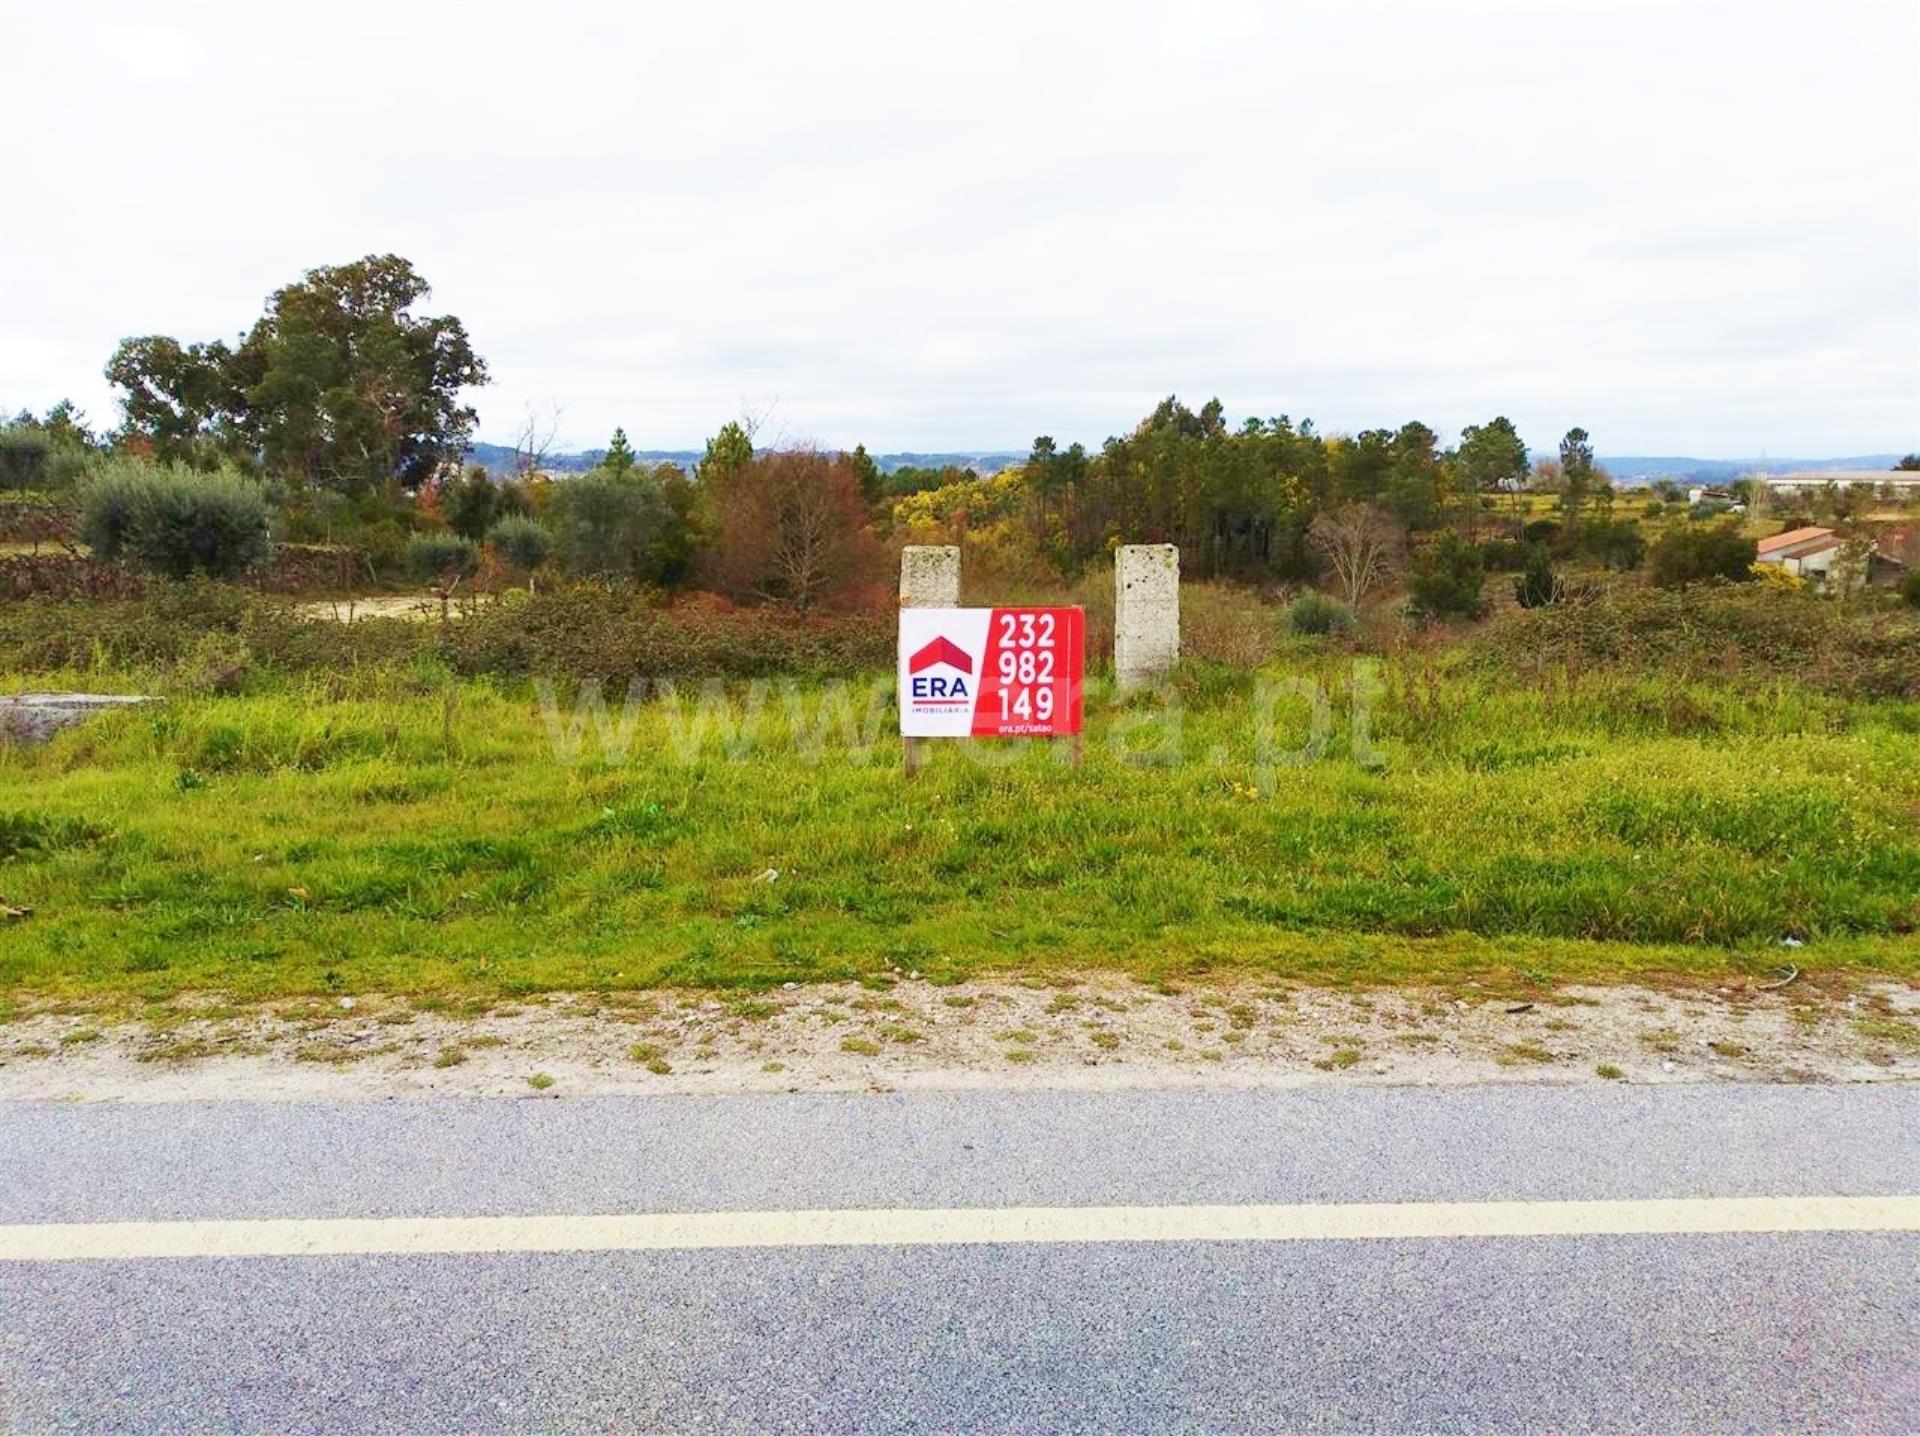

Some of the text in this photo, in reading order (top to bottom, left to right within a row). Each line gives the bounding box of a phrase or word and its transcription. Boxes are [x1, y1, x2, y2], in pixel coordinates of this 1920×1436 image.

[999, 614, 1055, 648] 232
[999, 650, 1054, 685] 982
[912, 677, 968, 697] ERA
[998, 686, 1054, 721] 149
